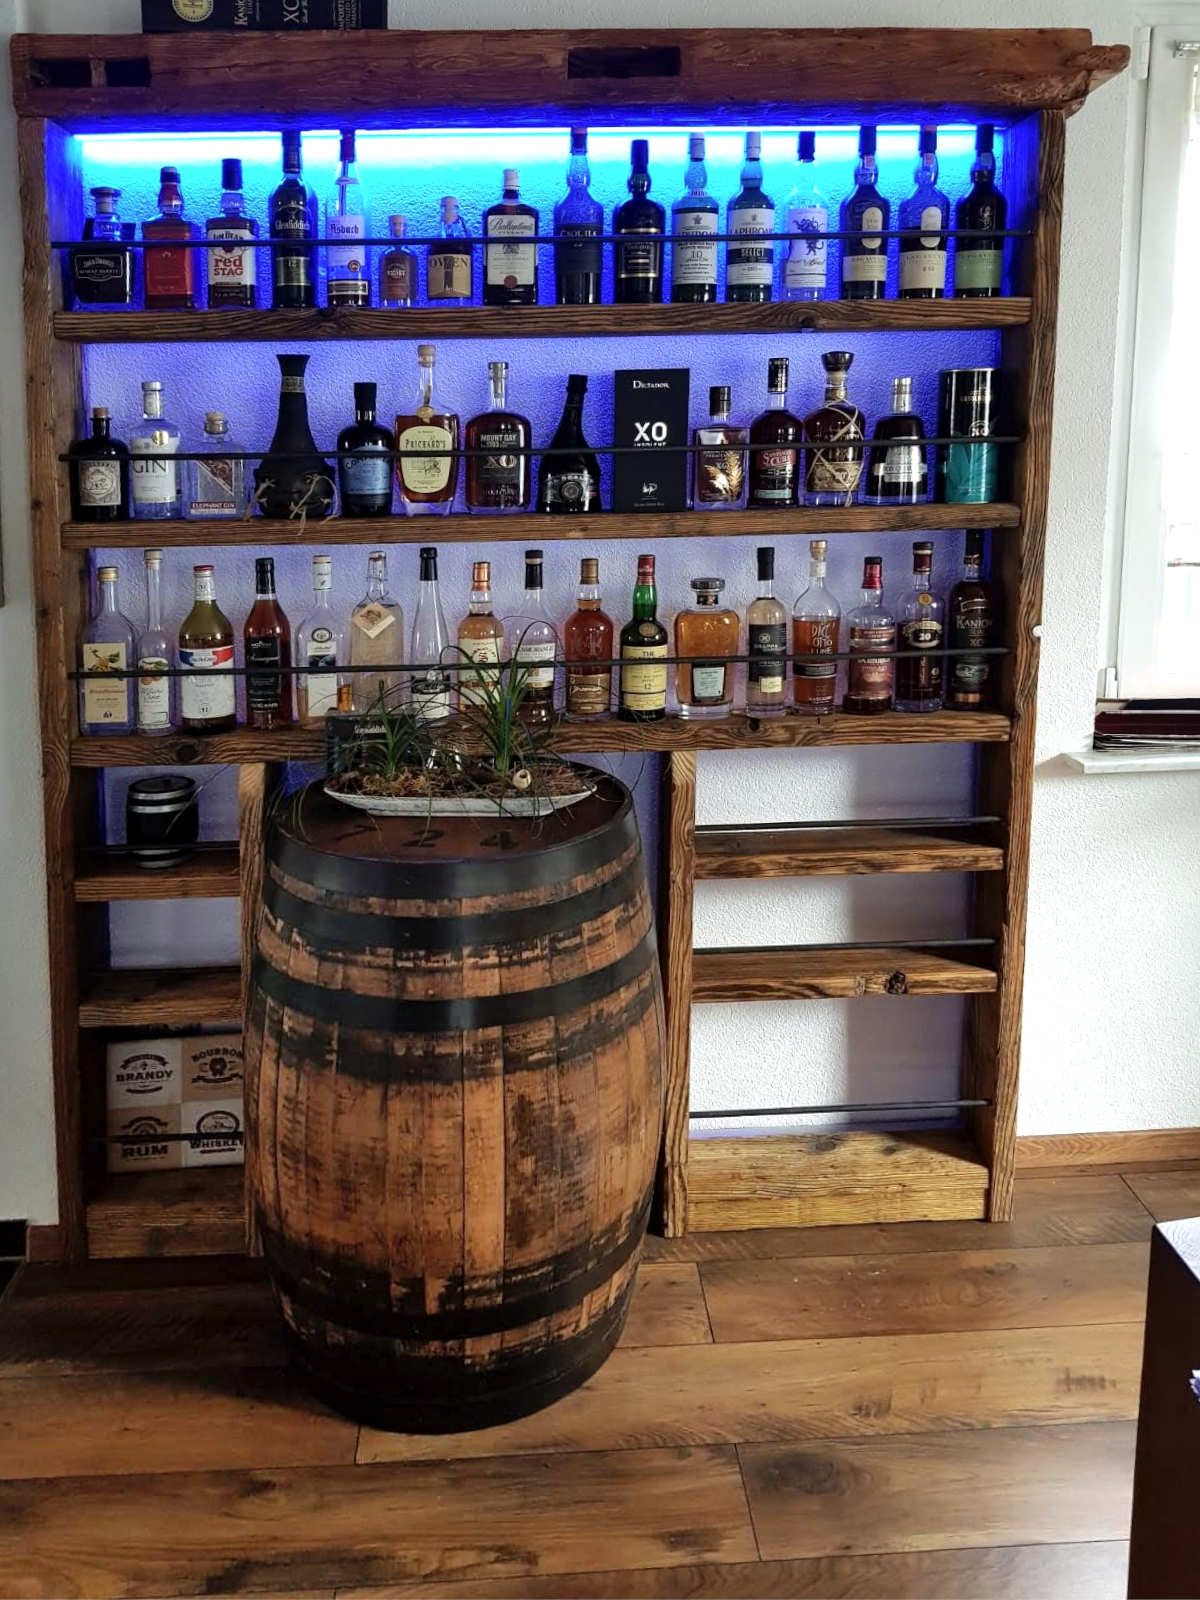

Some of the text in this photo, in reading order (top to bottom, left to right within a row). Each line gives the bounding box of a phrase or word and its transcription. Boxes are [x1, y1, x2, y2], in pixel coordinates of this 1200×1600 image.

[741, 248, 764, 257] SELECT
[214, 255, 242, 268] red
[633, 421, 668, 442] XO
[132, 459, 168, 473] GIN
[402, 829, 444, 848] 2
[480, 831, 519, 849] 4
[115, 1070, 174, 1082] BRANDY
[122, 1145, 168, 1158] RUM
